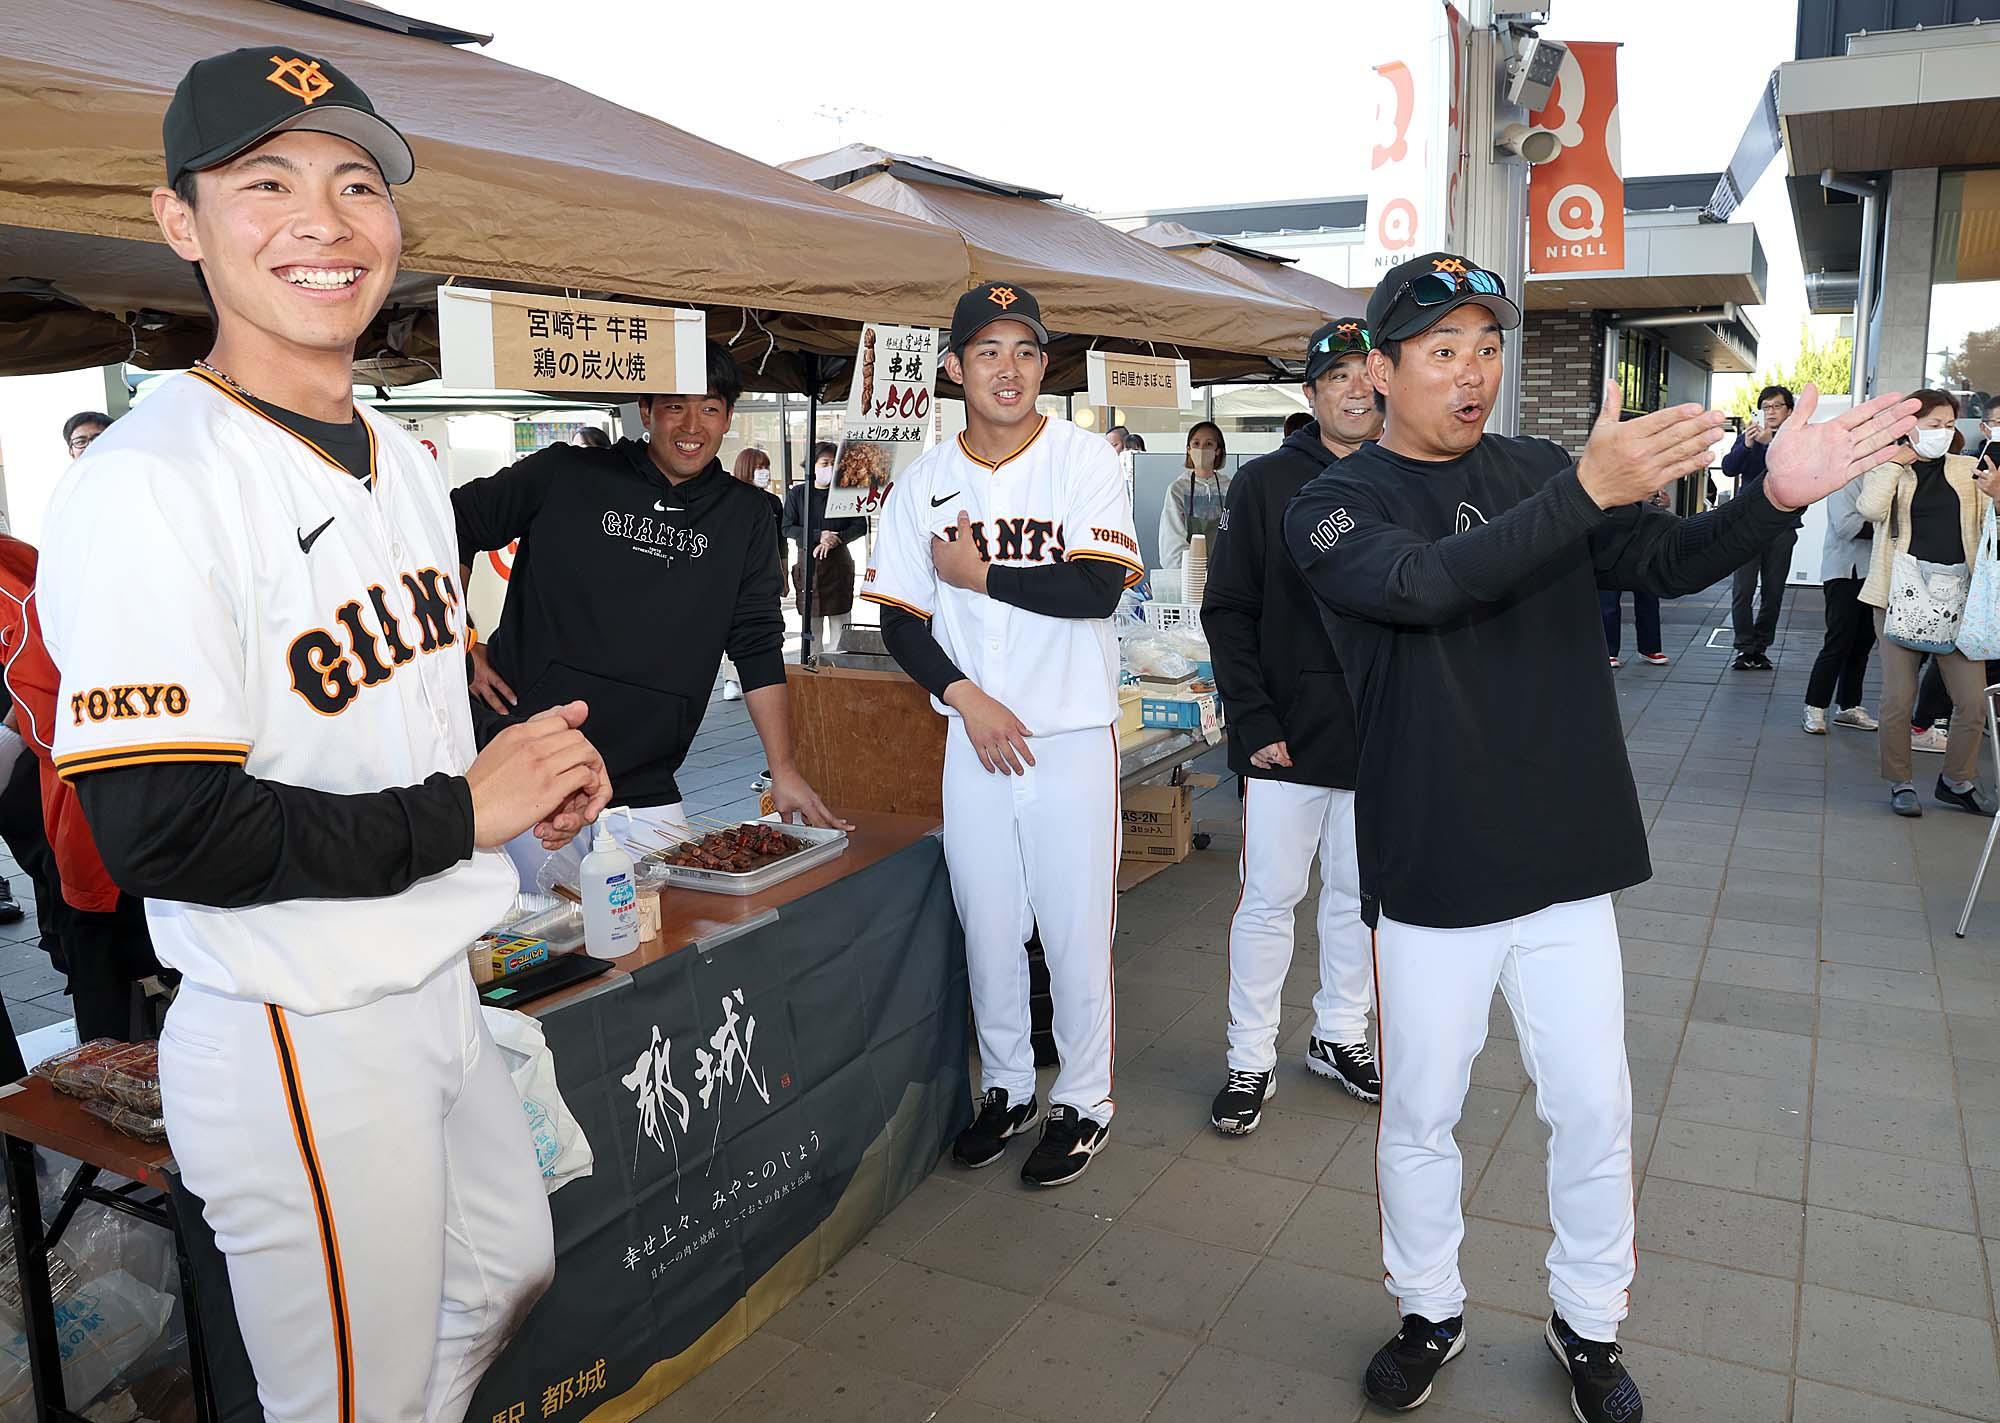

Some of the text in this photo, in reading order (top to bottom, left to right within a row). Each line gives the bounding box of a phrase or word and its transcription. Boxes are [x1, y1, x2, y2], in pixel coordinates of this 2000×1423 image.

[1546, 244, 1608, 259] NiQLL
[527, 308, 648, 345] 宮崎牛 牛串
[533, 346, 647, 382] 鶏の炭火焼
[888, 351, 923, 381] 串焼
[1111, 370, 1172, 389] 日向屋かまぼこ店
[874, 384, 930, 419] ¥500
[601, 510, 708, 559] GIANTS
[1309, 507, 1356, 553] 105
[70, 682, 190, 727] TOKYO
[711, 1129, 821, 1211] みやこのじょう
[540, 1357, 607, 1420] 都城
